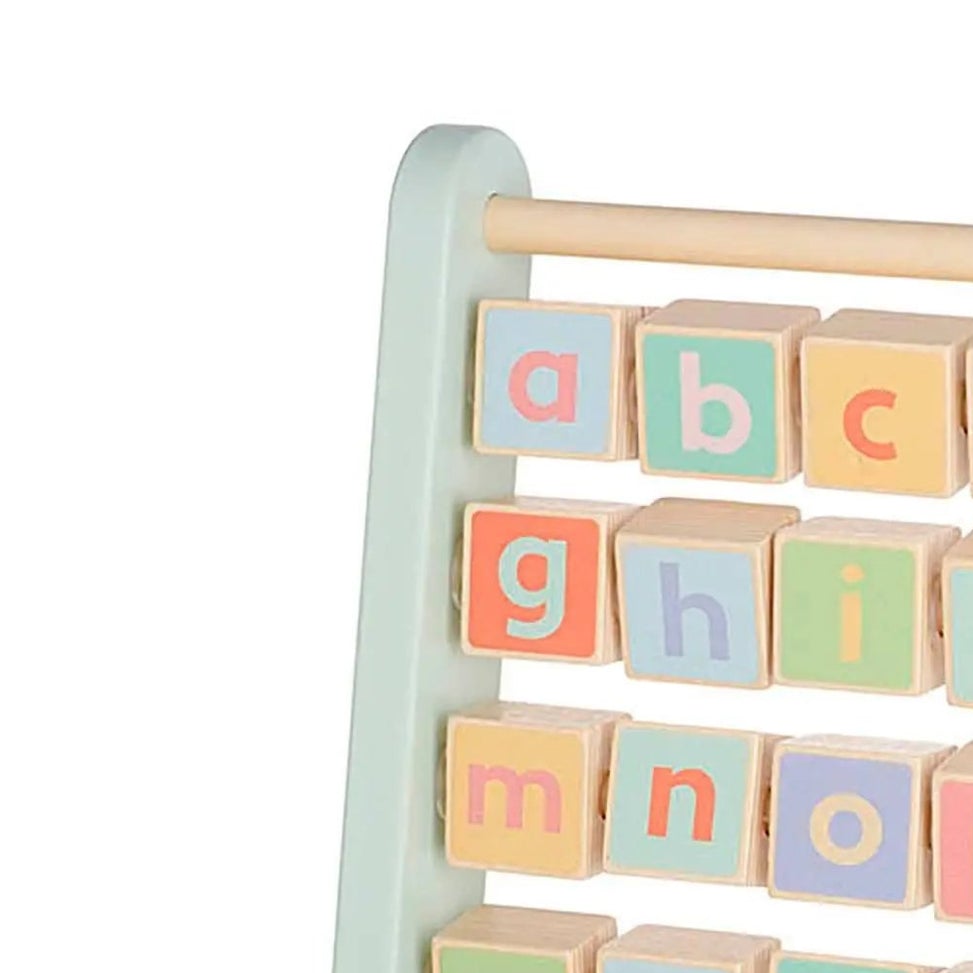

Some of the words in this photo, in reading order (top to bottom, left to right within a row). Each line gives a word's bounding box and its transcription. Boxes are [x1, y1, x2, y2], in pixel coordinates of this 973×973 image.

[508, 350, 578, 423] a
[679, 351, 752, 454] b
[842, 388, 897, 460] c
[498, 536, 567, 640] g
[659, 562, 730, 660] h
[839, 564, 864, 662] i
[467, 763, 562, 834] m
[647, 766, 715, 841] n
[809, 793, 883, 865] o
